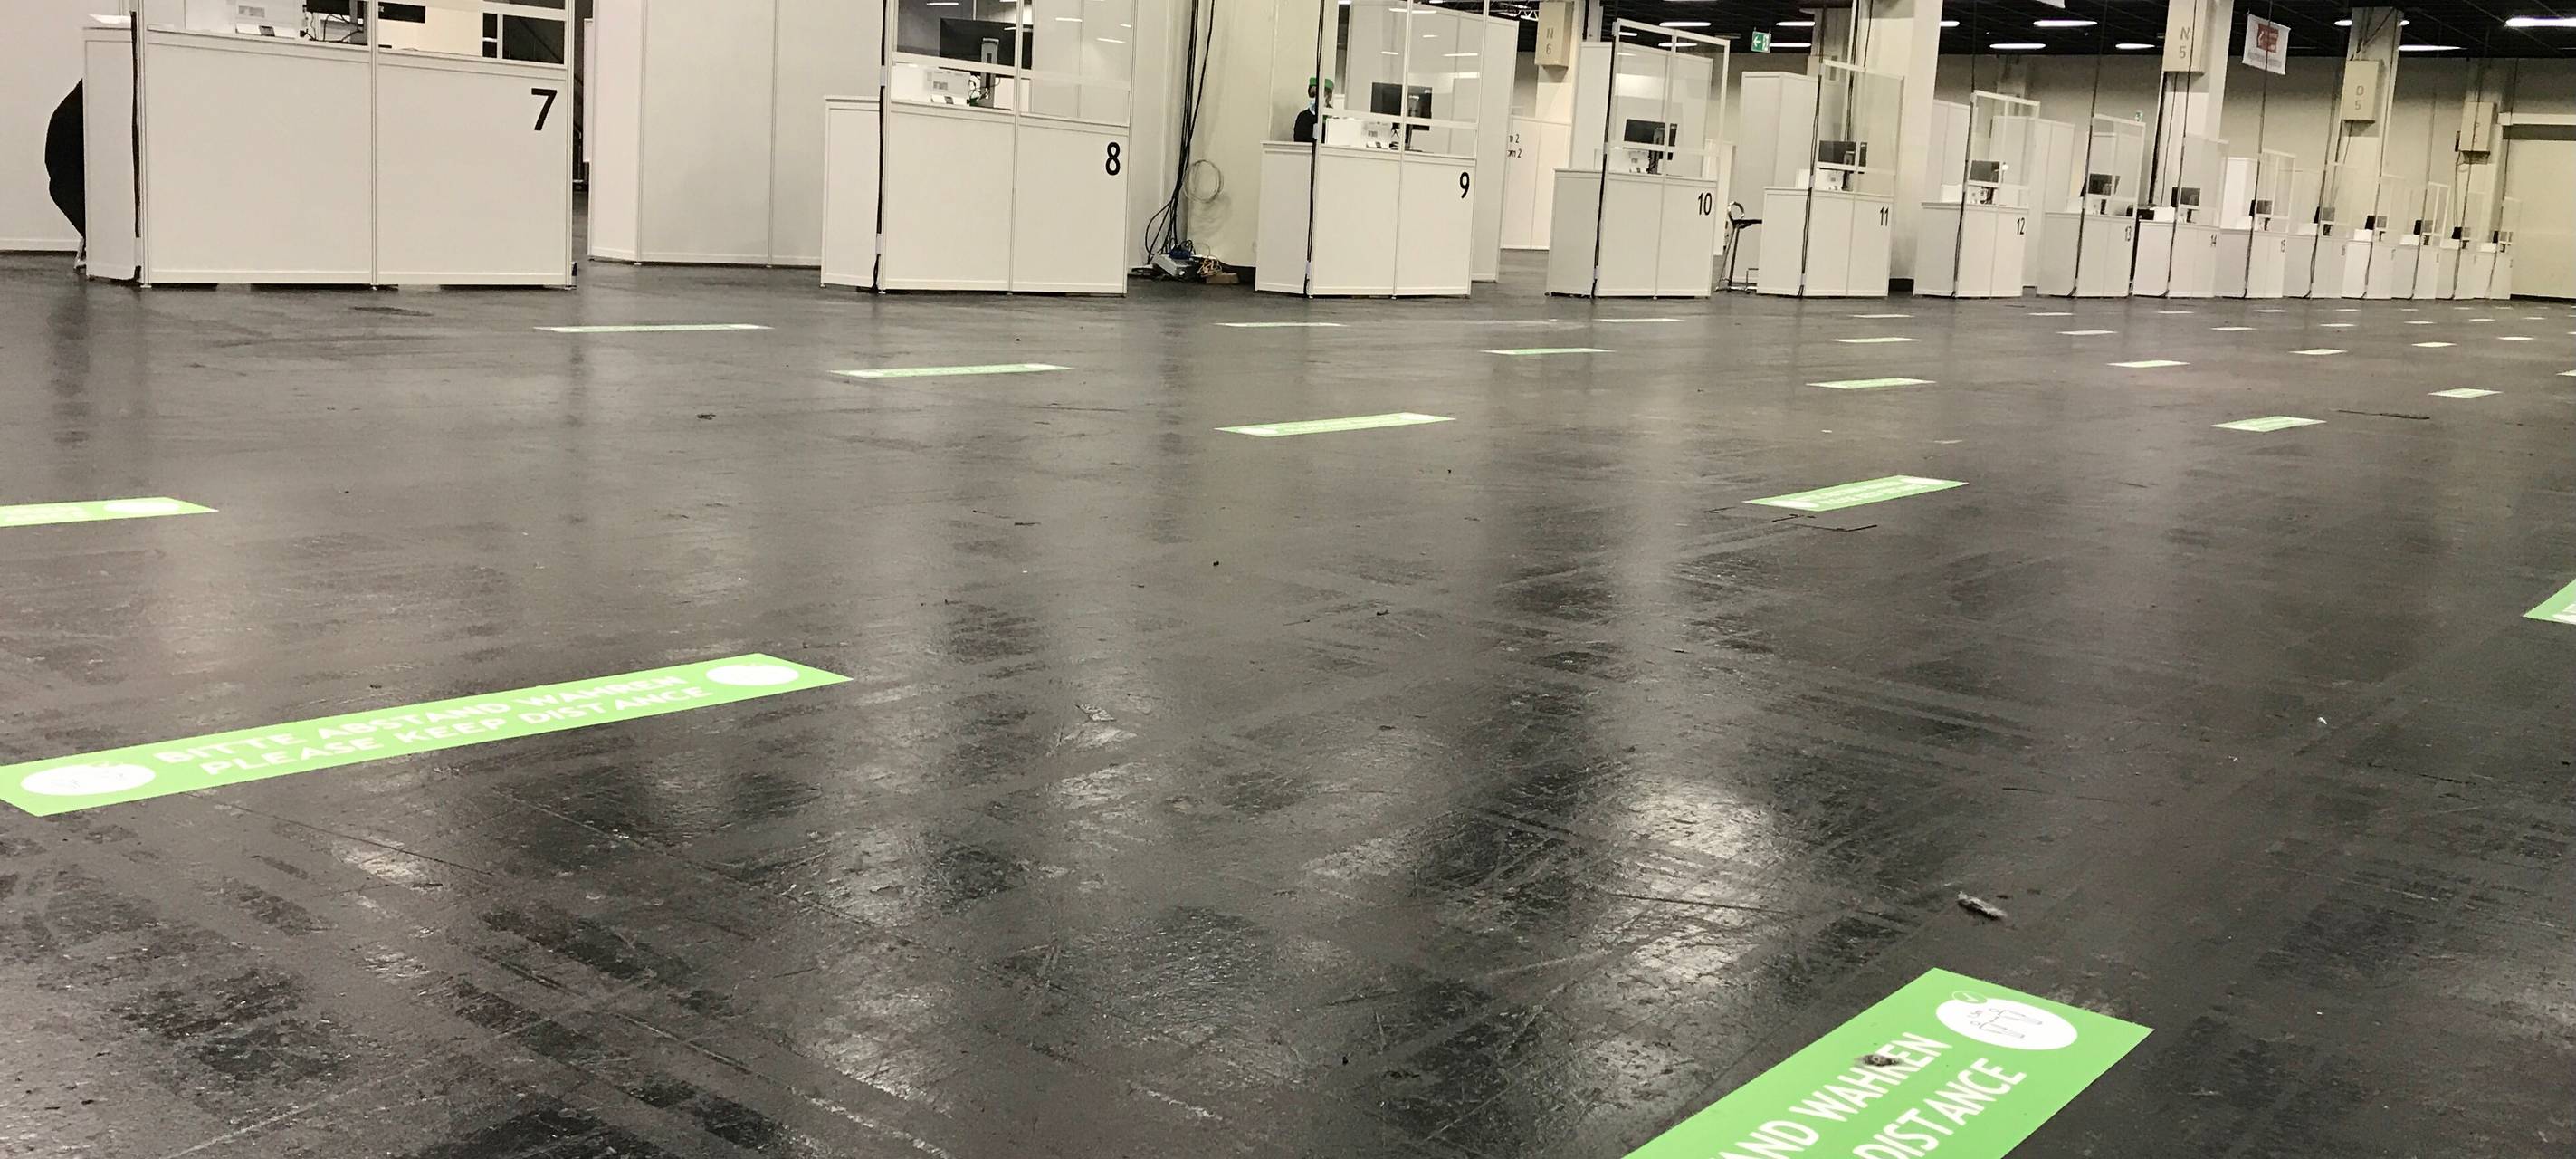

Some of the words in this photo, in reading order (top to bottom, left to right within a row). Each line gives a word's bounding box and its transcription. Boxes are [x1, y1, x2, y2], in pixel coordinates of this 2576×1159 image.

[1546, 27, 1554, 39] N
[2180, 26, 2190, 40] N
[1545, 43, 1551, 55] 6
[2179, 45, 2187, 59] 5
[530, 87, 558, 131] 7
[2354, 100, 2361, 110] 5
[1515, 133, 1520, 144] 2
[1105, 141, 1121, 176] 8
[1517, 148, 1522, 158] 2
[1459, 171, 1470, 199] 9
[1697, 192, 1713, 216] 10
[1879, 206, 1889, 227] 11
[2017, 217, 2026, 235] 12
[154, 733, 307, 763] BITTE
[317, 703, 512, 741] ABSTAND
[515, 675, 688, 707] WAHREN
[199, 737, 384, 775] PLEASE
[395, 718, 507, 744] KEEP
[519, 686, 713, 724] DISTANCE
[1716, 1120, 1819, 1159] ND
[1789, 1031, 1952, 1122] WAHREN
